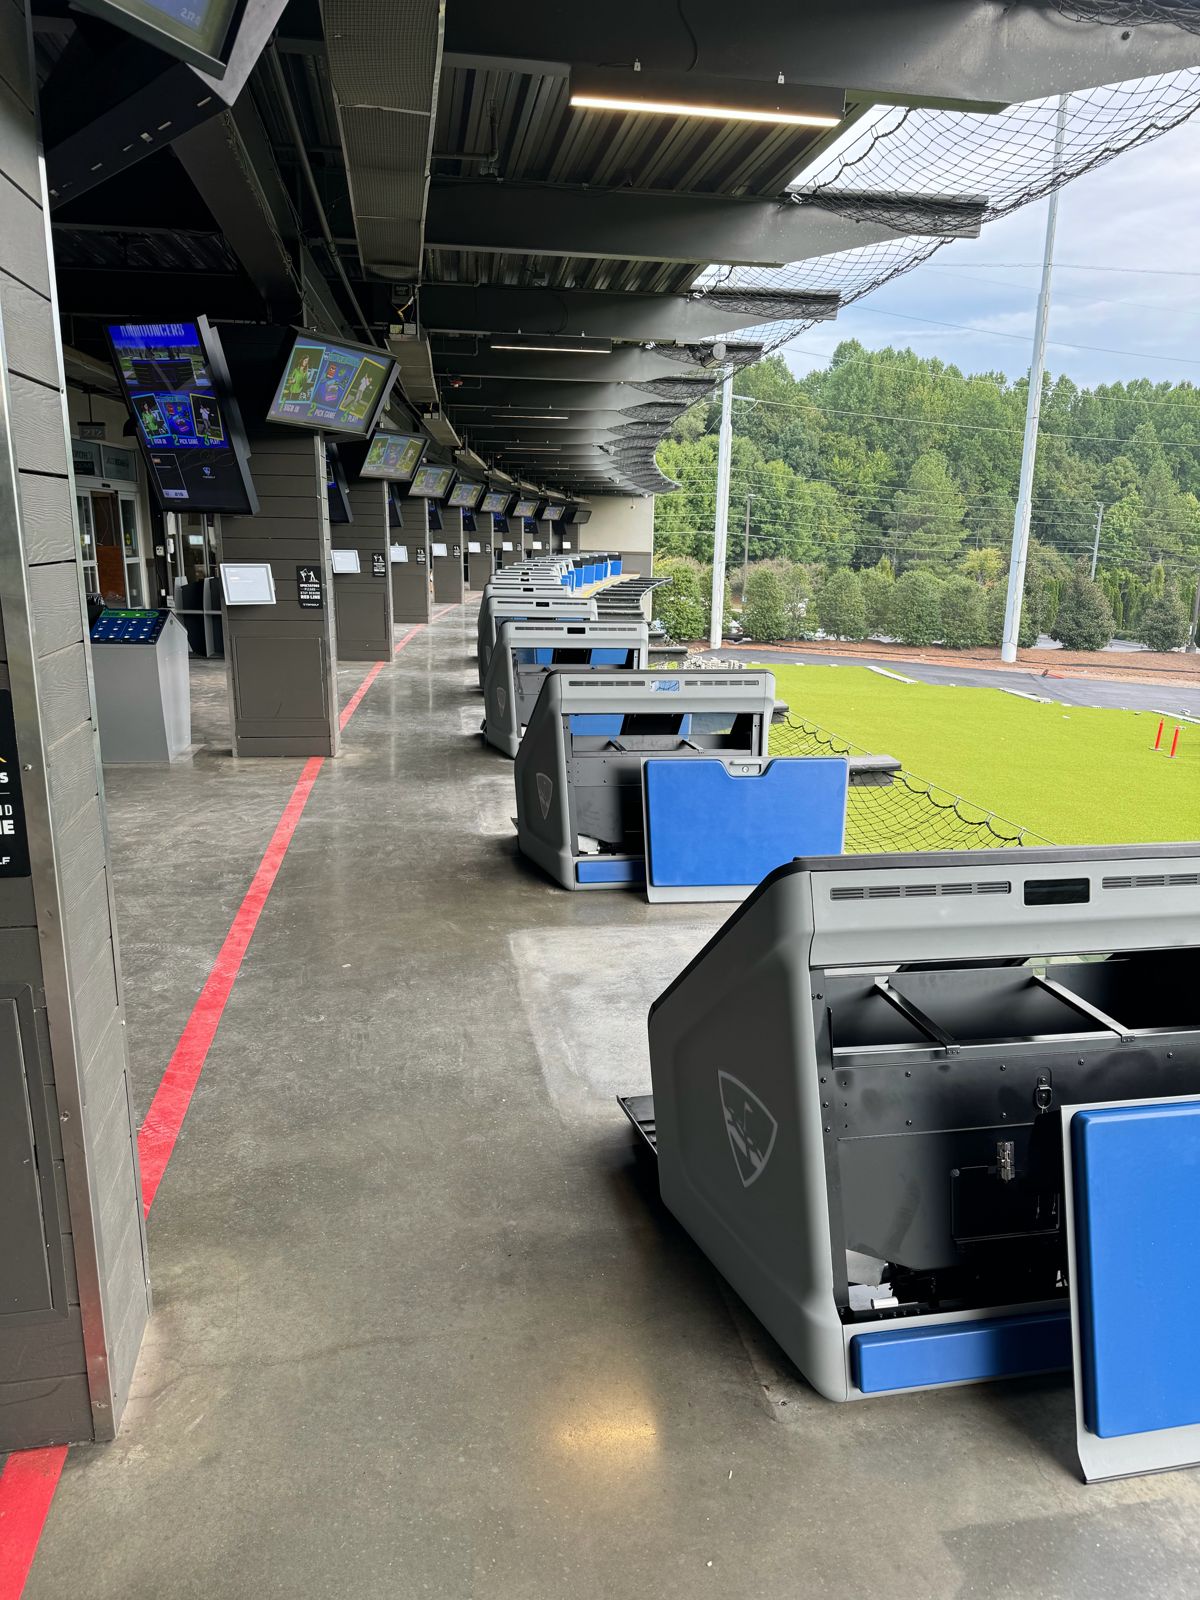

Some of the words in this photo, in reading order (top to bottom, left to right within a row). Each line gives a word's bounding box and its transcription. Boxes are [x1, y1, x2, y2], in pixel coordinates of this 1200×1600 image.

[307, 402, 317, 416] 2
[315, 408, 325, 417] PICK
[325, 409, 337, 419] GAME
[172, 434, 180, 446] 2
